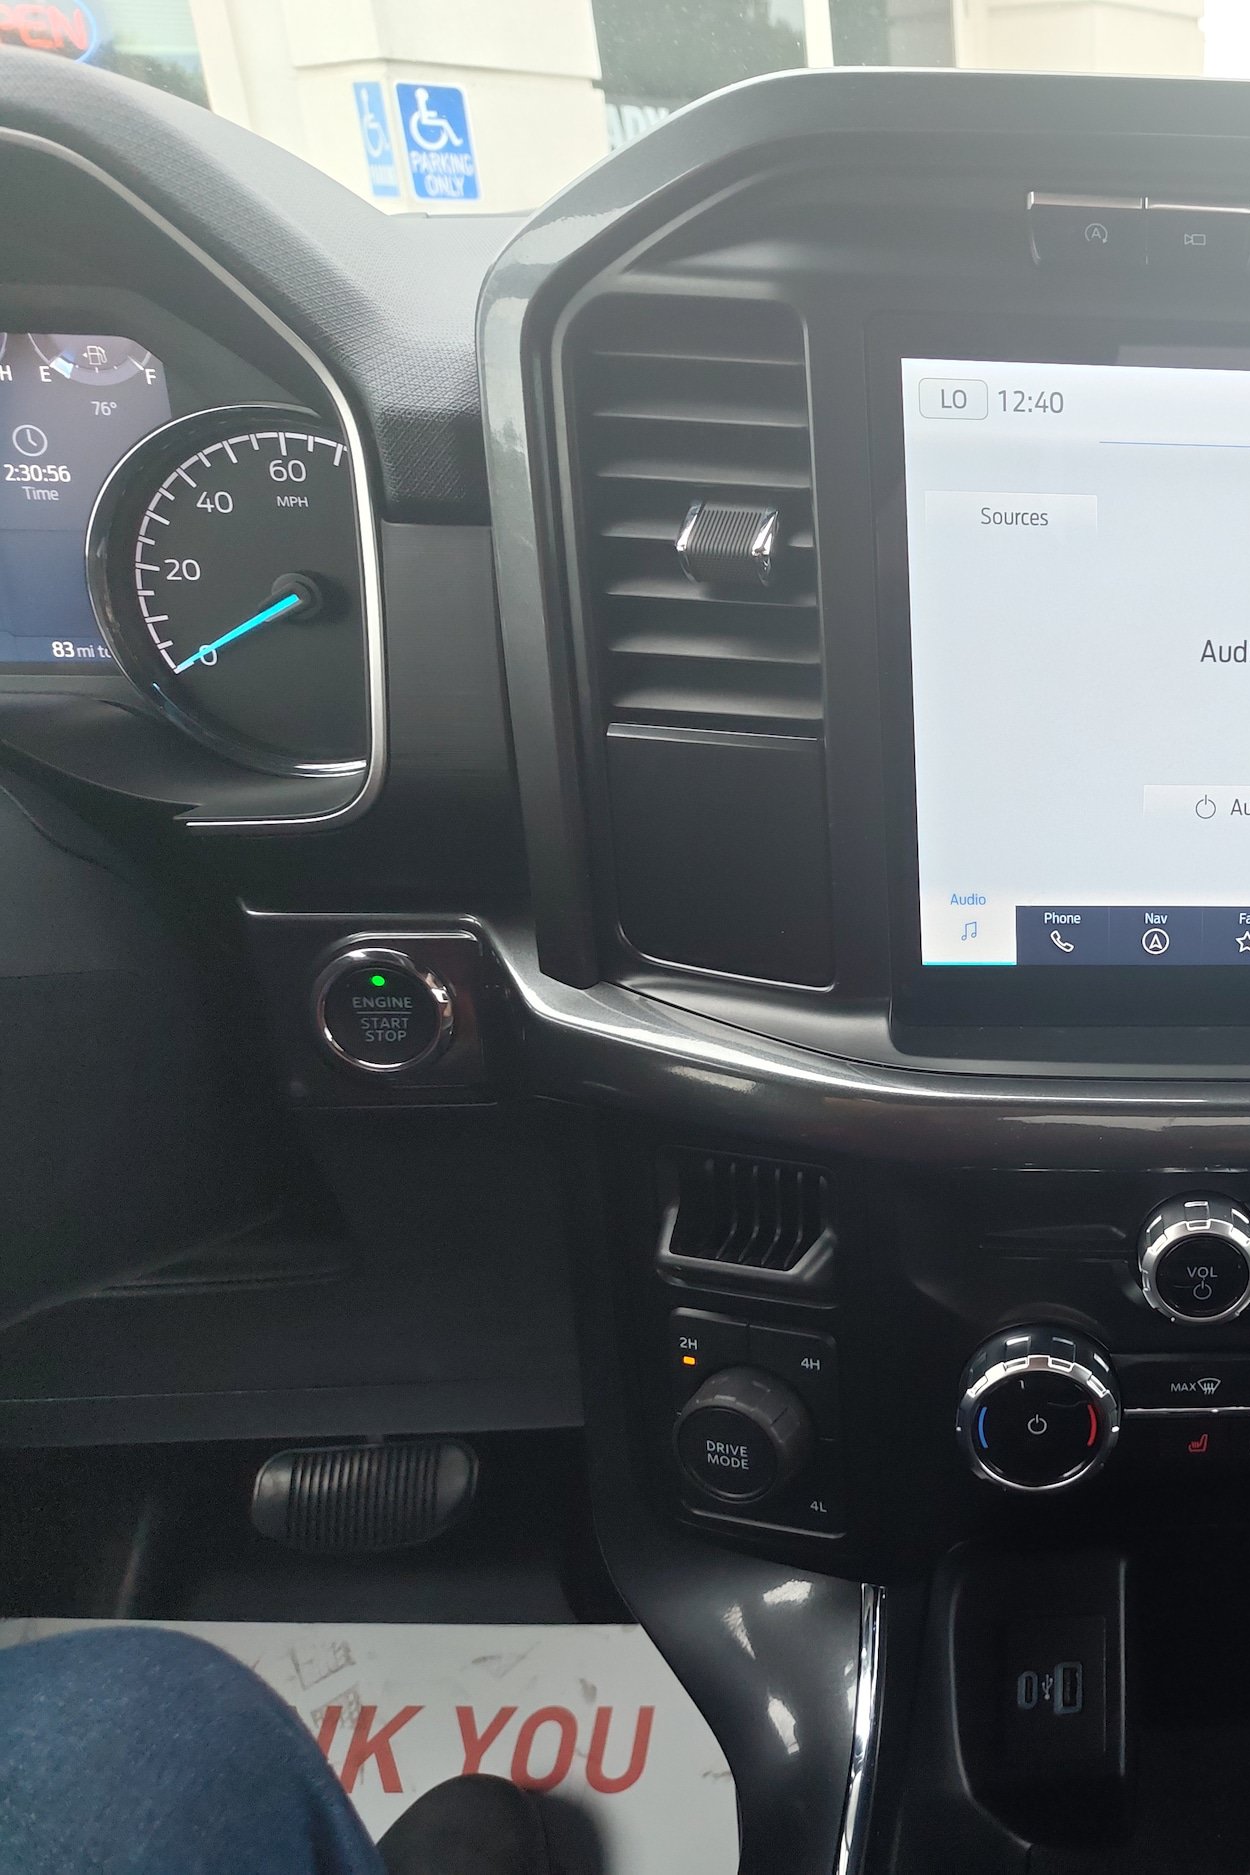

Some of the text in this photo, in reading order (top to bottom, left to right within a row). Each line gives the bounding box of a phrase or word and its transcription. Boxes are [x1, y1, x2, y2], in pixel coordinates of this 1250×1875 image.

[410, 150, 474, 177] PARKING
[424, 174, 465, 197] ONLY
[40, 366, 52, 382] E
[145, 369, 156, 385] F
[940, 388, 967, 409] LO
[997, 390, 1064, 414] 12:40
[3, 464, 72, 483] 2:30:56
[269, 459, 307, 482] 60
[22, 486, 60, 501] Time
[276, 495, 309, 508] MPH
[196, 491, 234, 514] 40
[980, 506, 1049, 527] Sources
[164, 558, 201, 581] 20
[52, 641, 75, 658] 83
[77, 645, 95, 658] mi
[199, 644, 218, 666] 0
[950, 893, 986, 906] Audio
[1044, 912, 1081, 926] Phone
[1144, 912, 1168, 925] Nav
[352, 996, 413, 1009] ENGINE
[361, 1017, 409, 1030] START
[365, 1029, 407, 1042] STOP
[1186, 1266, 1218, 1279] VOL
[679, 1336, 698, 1350] 2H
[800, 1357, 821, 1371] 4H
[1170, 1382, 1197, 1392] MAX
[706, 1439, 748, 1458] DRIVE
[707, 1453, 750, 1470] MODE
[810, 1500, 828, 1513] 4L
[455, 1704, 656, 1795] YOU
